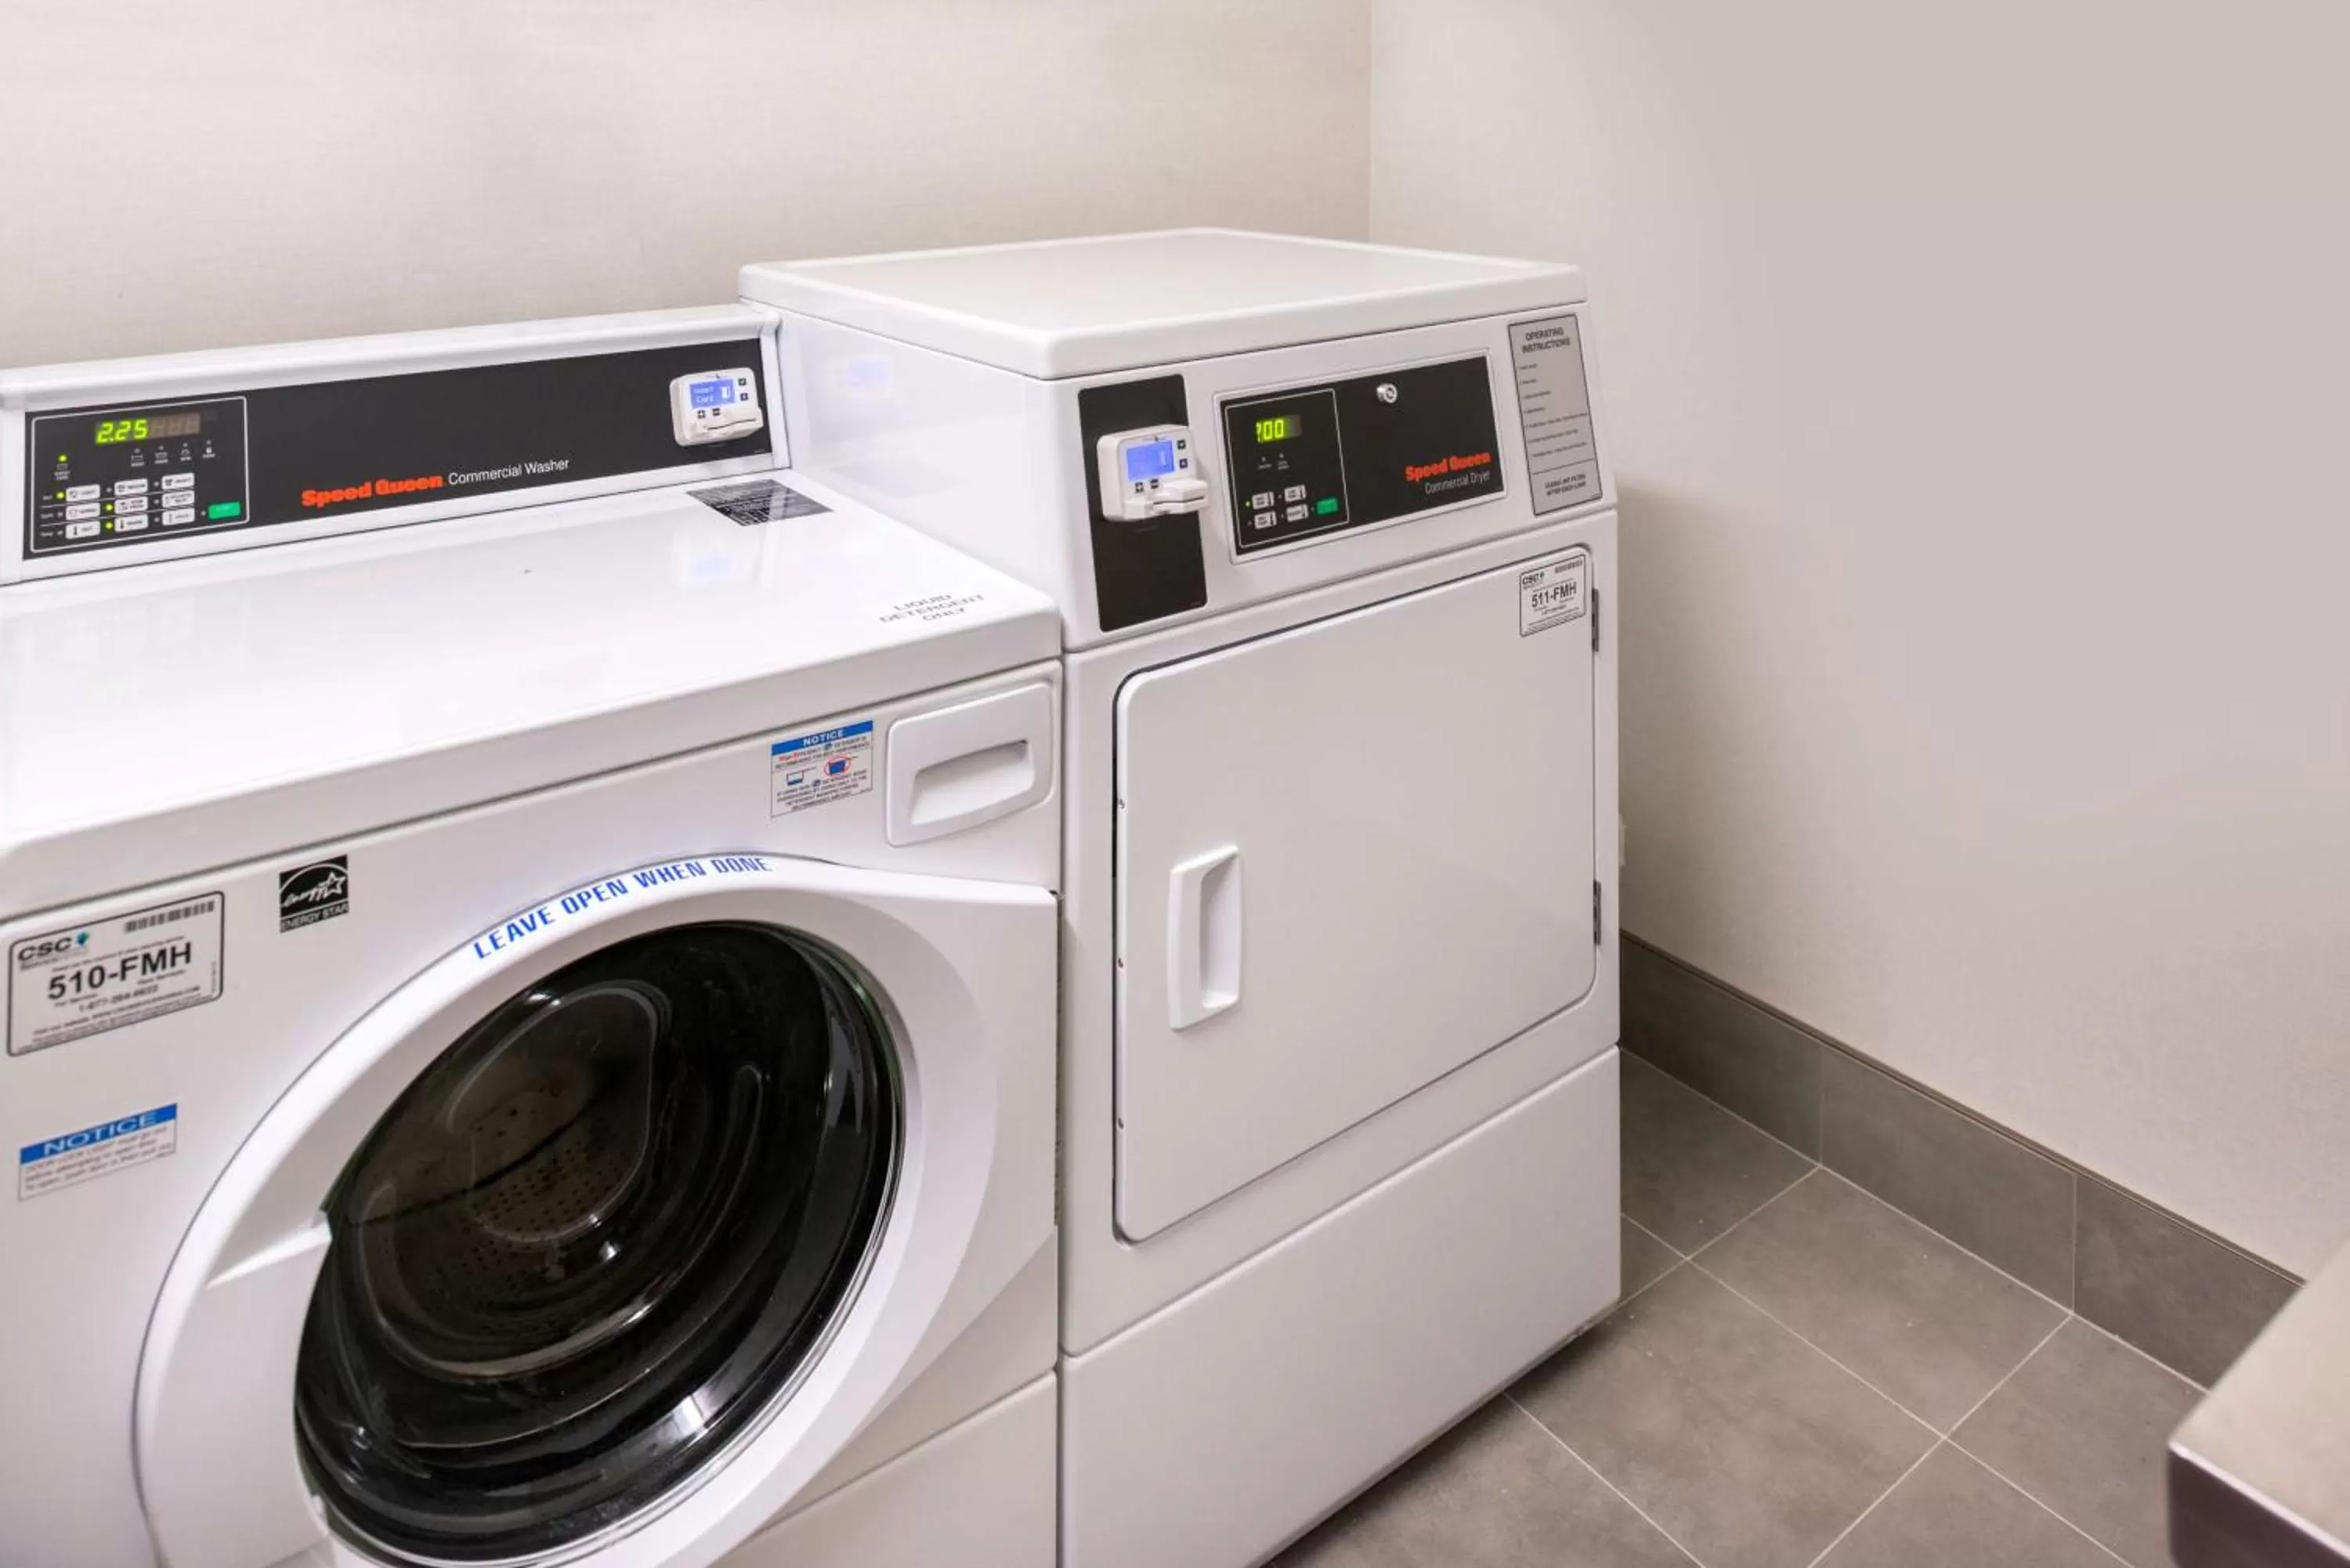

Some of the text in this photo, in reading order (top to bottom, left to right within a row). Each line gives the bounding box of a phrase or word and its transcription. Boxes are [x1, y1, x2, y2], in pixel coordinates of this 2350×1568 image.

[1521, 337, 1570, 353] INSTRUCTIONS
[1525, 327, 1564, 340] OPERATING
[95, 419, 147, 444] 2.25
[1405, 451, 1492, 481] Speed Queen
[301, 458, 569, 508] Speed Queen Commercial Washer
[1425, 471, 1490, 494] Commercial Dryer
[892, 594, 952, 610] LIQUID
[1531, 580, 1577, 609] 511-FMH
[879, 594, 985, 623] DETERGENT
[922, 607, 965, 621] ONLY
[802, 729, 844, 746] NOTICE
[473, 857, 774, 959] LEAVE OPEN WHEN DONE
[17, 937, 72, 962] CSC
[47, 941, 193, 1000] 510-FMH
[43, 1111, 157, 1156] NOTICE
